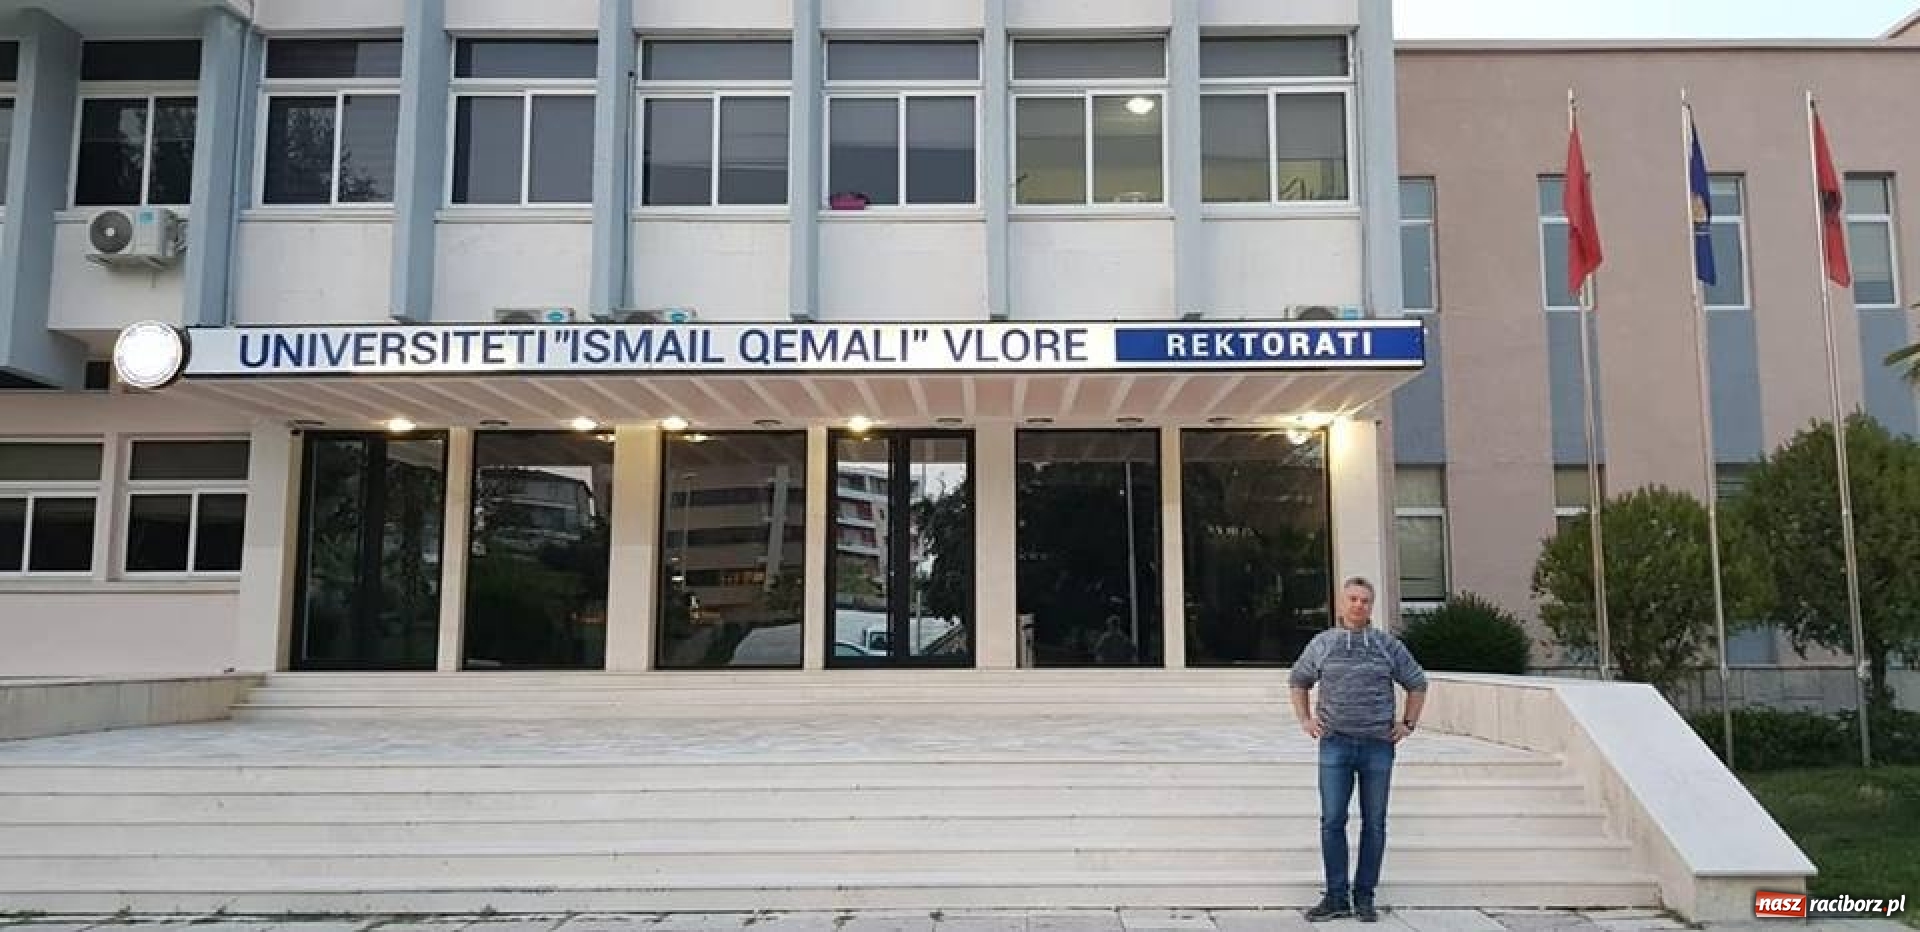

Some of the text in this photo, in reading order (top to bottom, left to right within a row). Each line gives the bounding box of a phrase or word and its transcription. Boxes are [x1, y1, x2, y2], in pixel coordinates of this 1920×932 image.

[239, 329, 547, 369] UNIVERSITETI
[942, 328, 1089, 363] VLORE
[1166, 331, 1371, 357] REKTORATI
